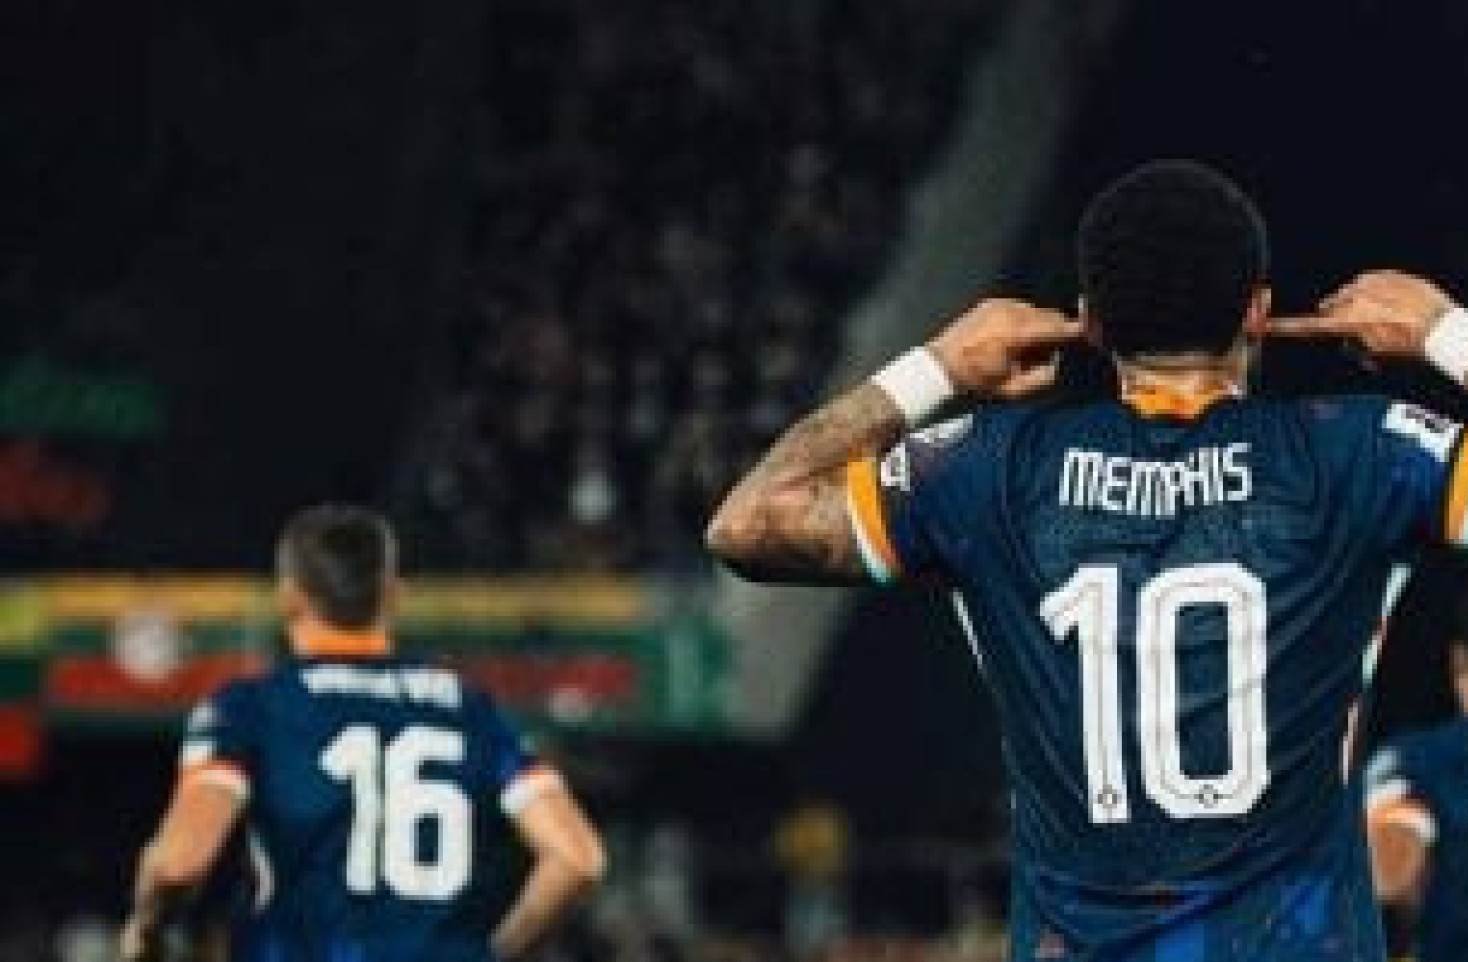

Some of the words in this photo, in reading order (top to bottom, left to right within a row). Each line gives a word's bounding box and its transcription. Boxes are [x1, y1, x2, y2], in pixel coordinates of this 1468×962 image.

[1058, 442, 1253, 520] MEMPHIS
[1039, 561, 1271, 824] 10
[318, 724, 474, 902] 16
